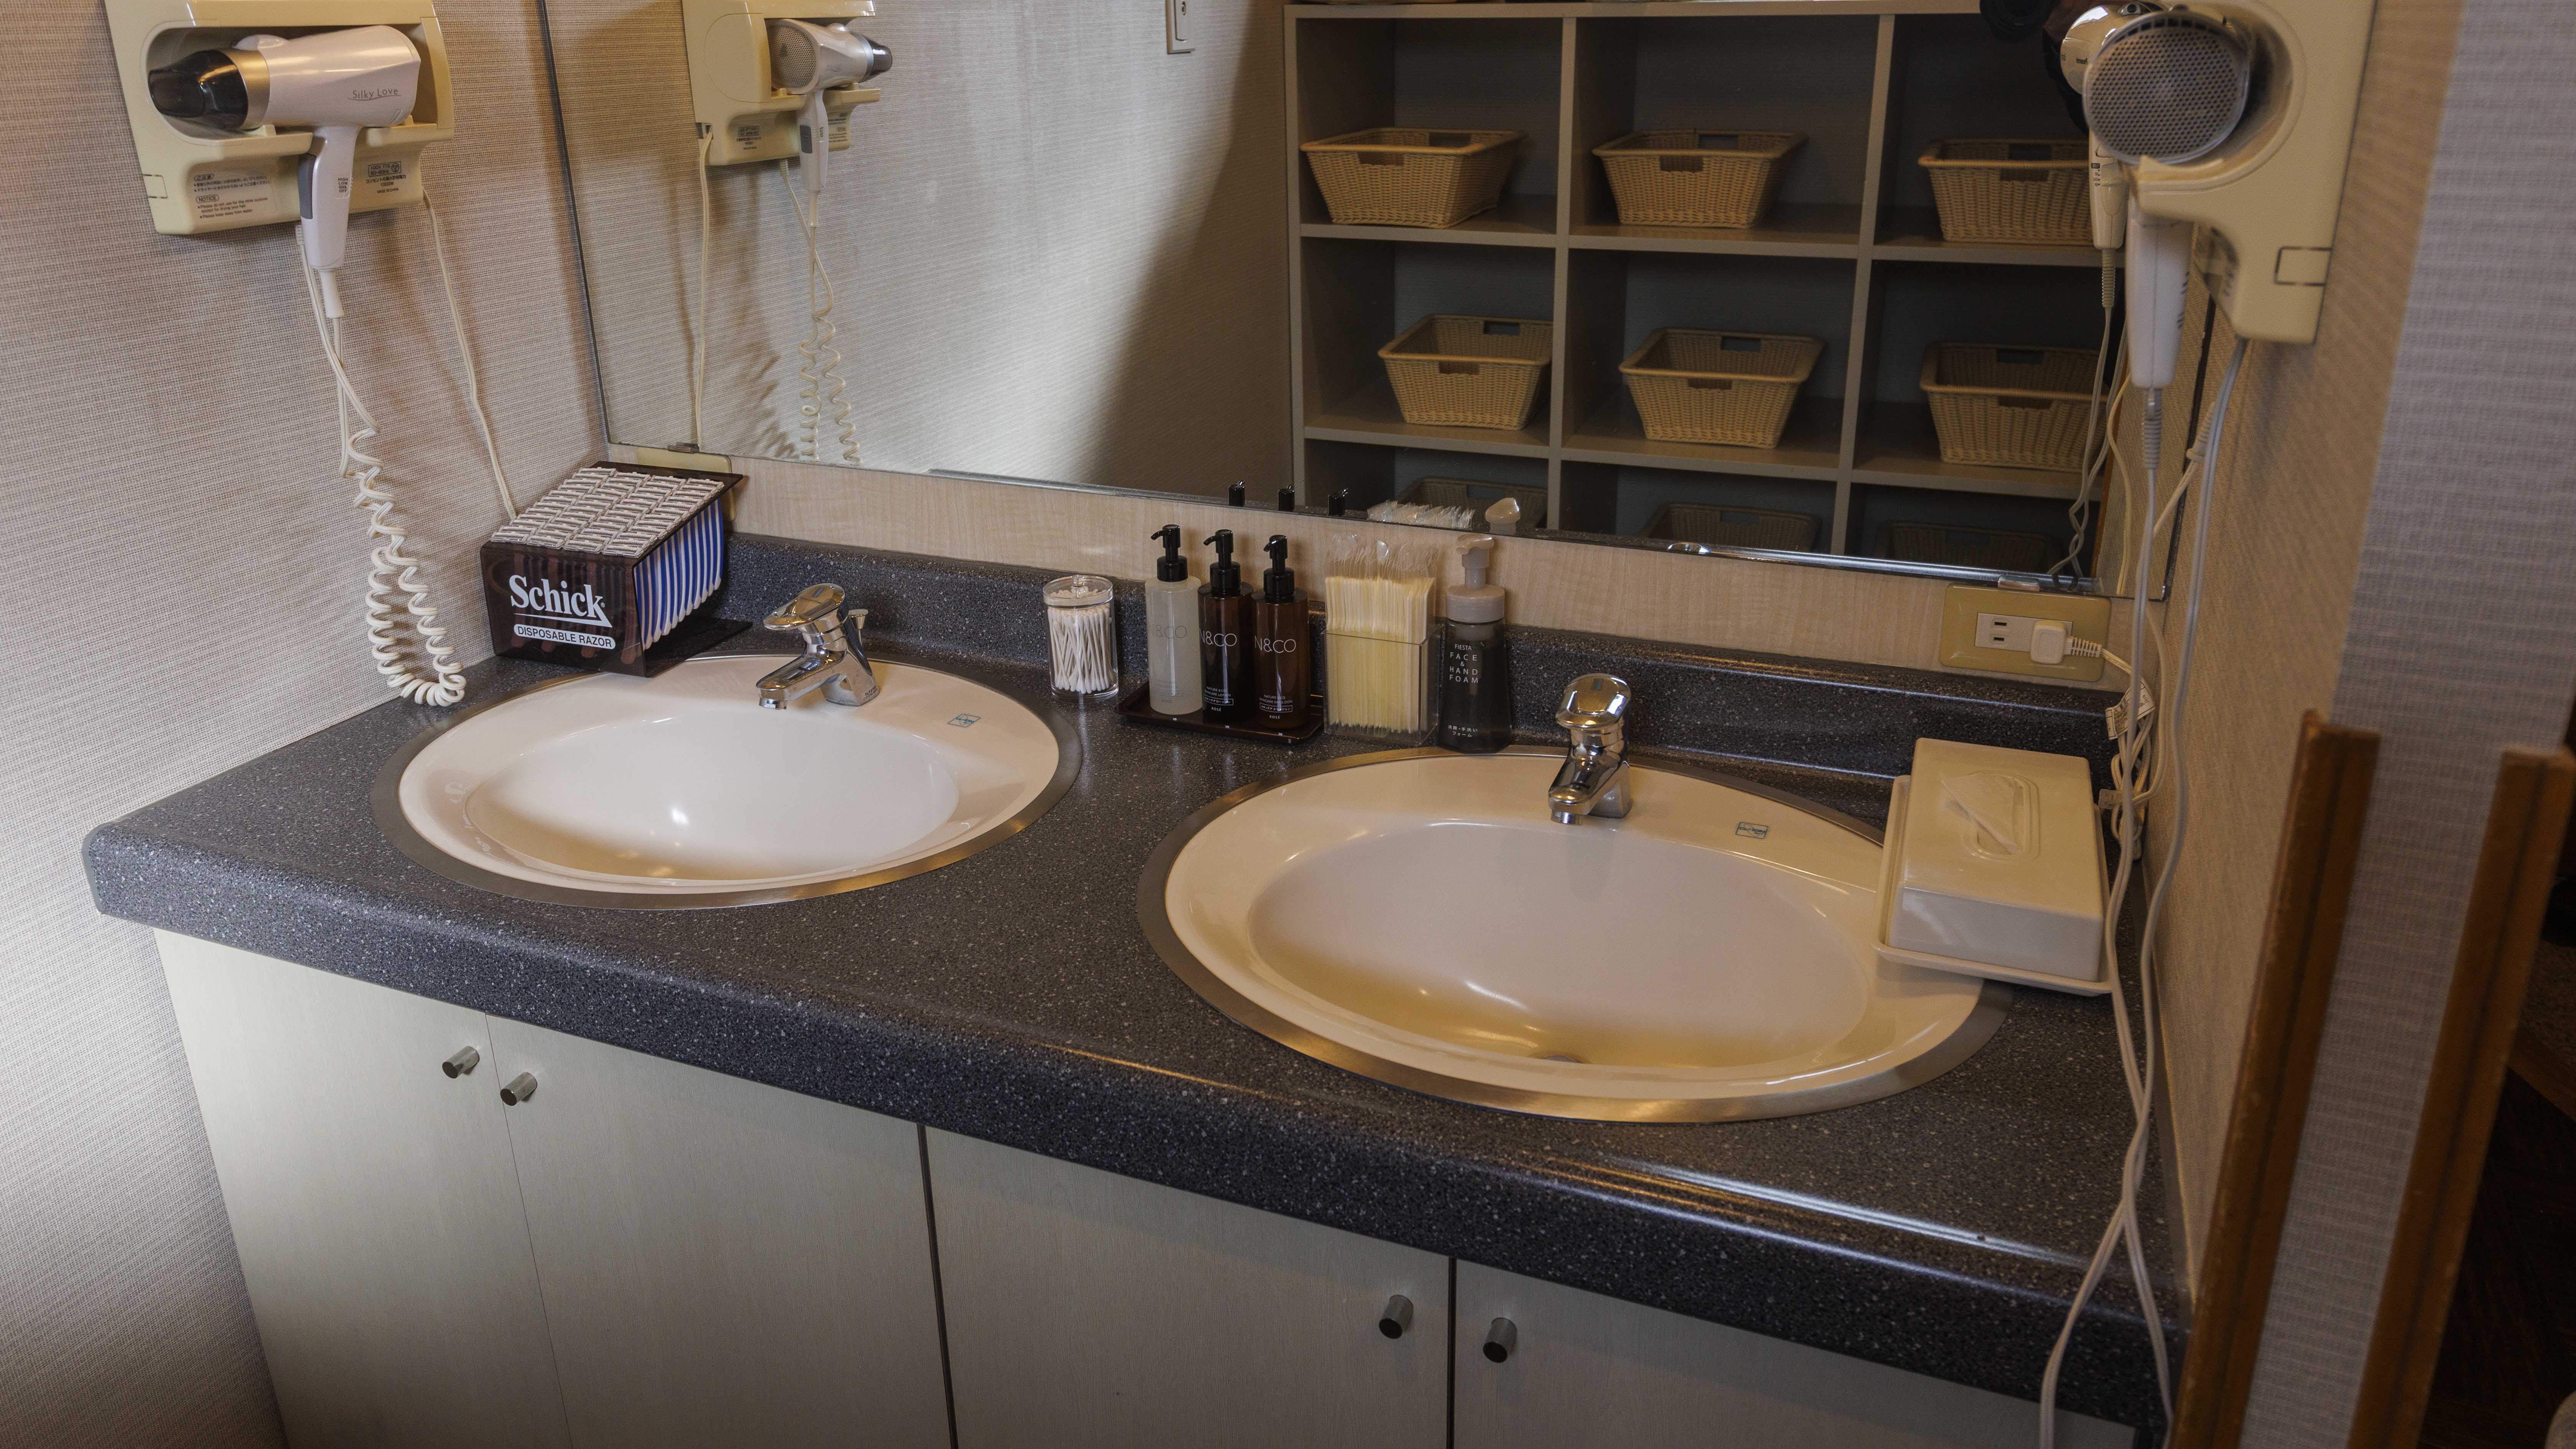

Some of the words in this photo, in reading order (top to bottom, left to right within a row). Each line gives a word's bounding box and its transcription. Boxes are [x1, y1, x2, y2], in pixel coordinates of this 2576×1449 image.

[352, 90, 374, 100] Silky
[509, 575, 613, 627] Schick
[517, 626, 577, 642] DISPOSABLE
[579, 635, 612, 647] RAZOR
[1254, 636, 1296, 653] N&CO
[1450, 652, 1478, 661] FACE
[1450, 666, 1478, 675] HAND
[1450, 674, 1478, 683] FOAM
